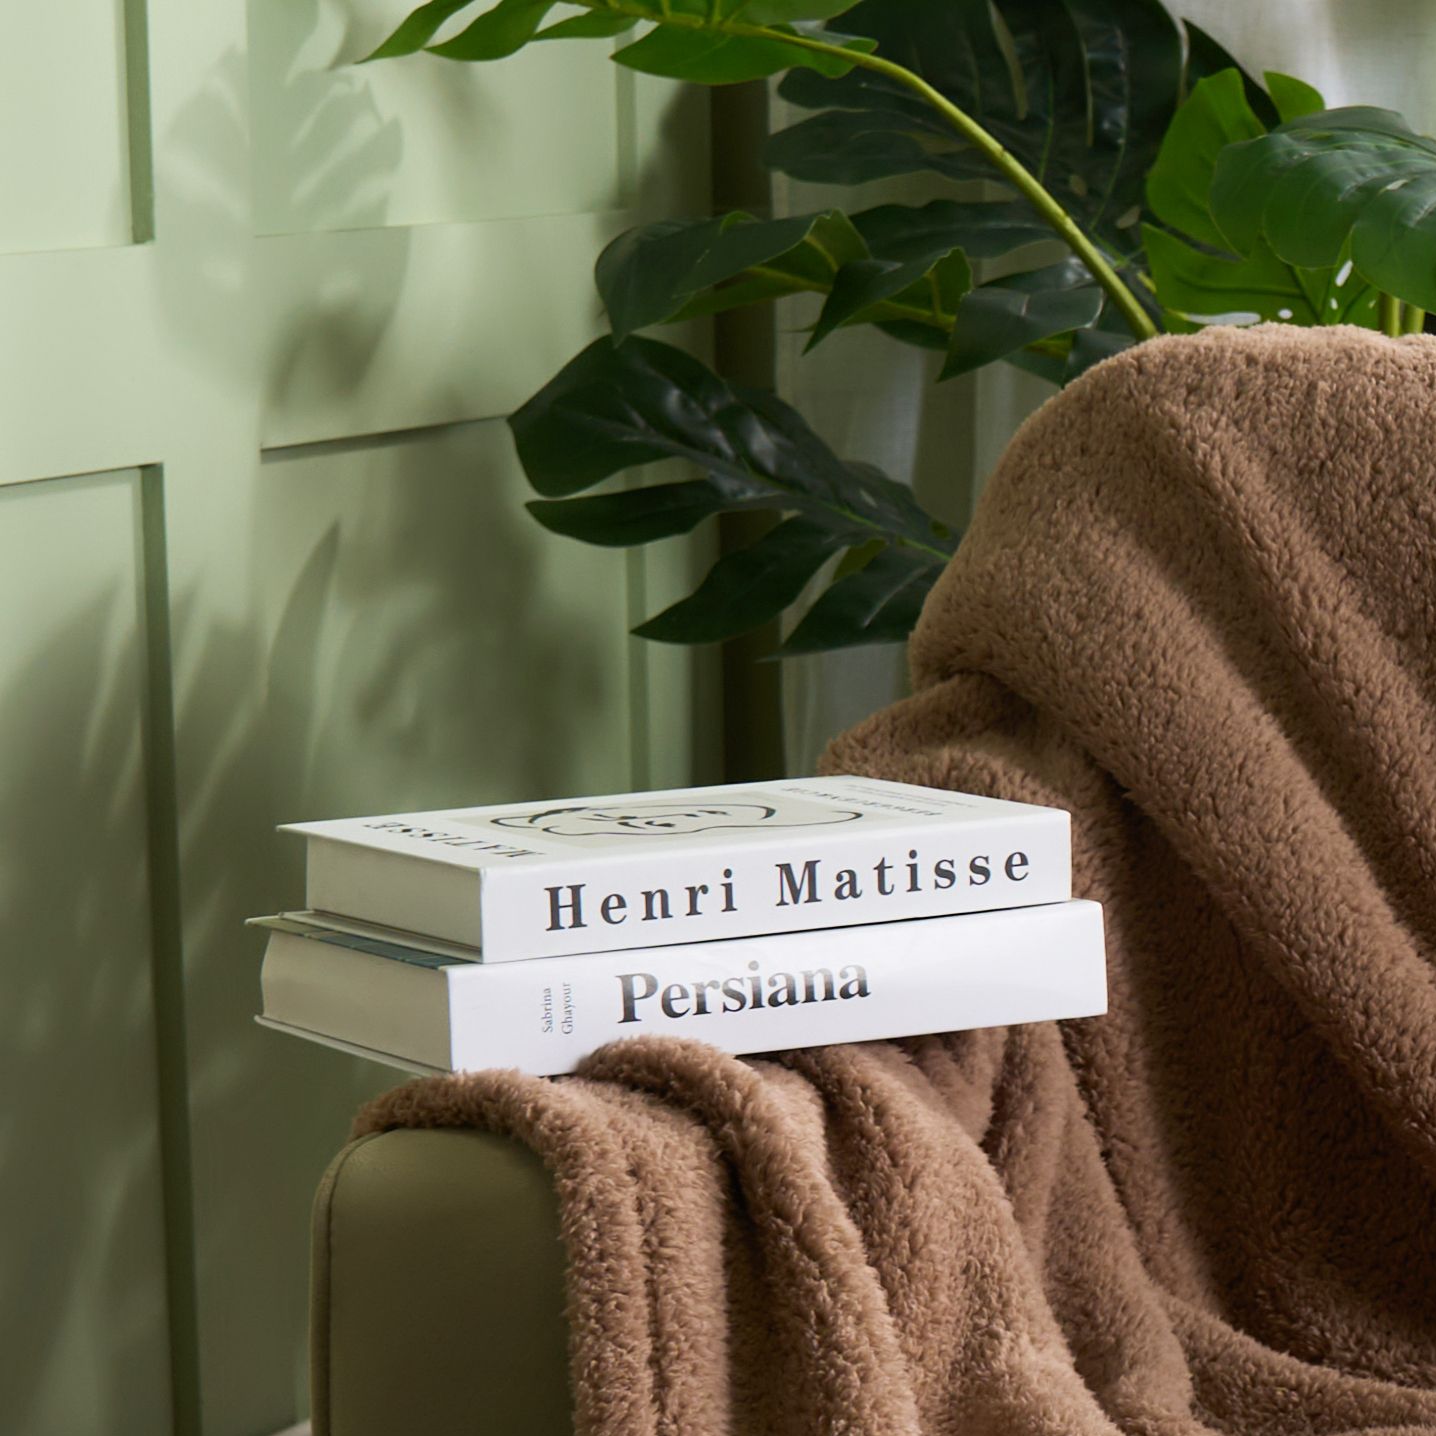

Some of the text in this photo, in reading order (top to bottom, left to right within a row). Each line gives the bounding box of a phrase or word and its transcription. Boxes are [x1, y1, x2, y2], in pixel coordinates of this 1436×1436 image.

[362, 822, 545, 858] MATISSE
[544, 849, 1031, 931] Henri Matisse
[541, 987, 553, 1034] Sabrina
[560, 981, 575, 1035] Ghayour
[615, 961, 872, 1024] Persiana
